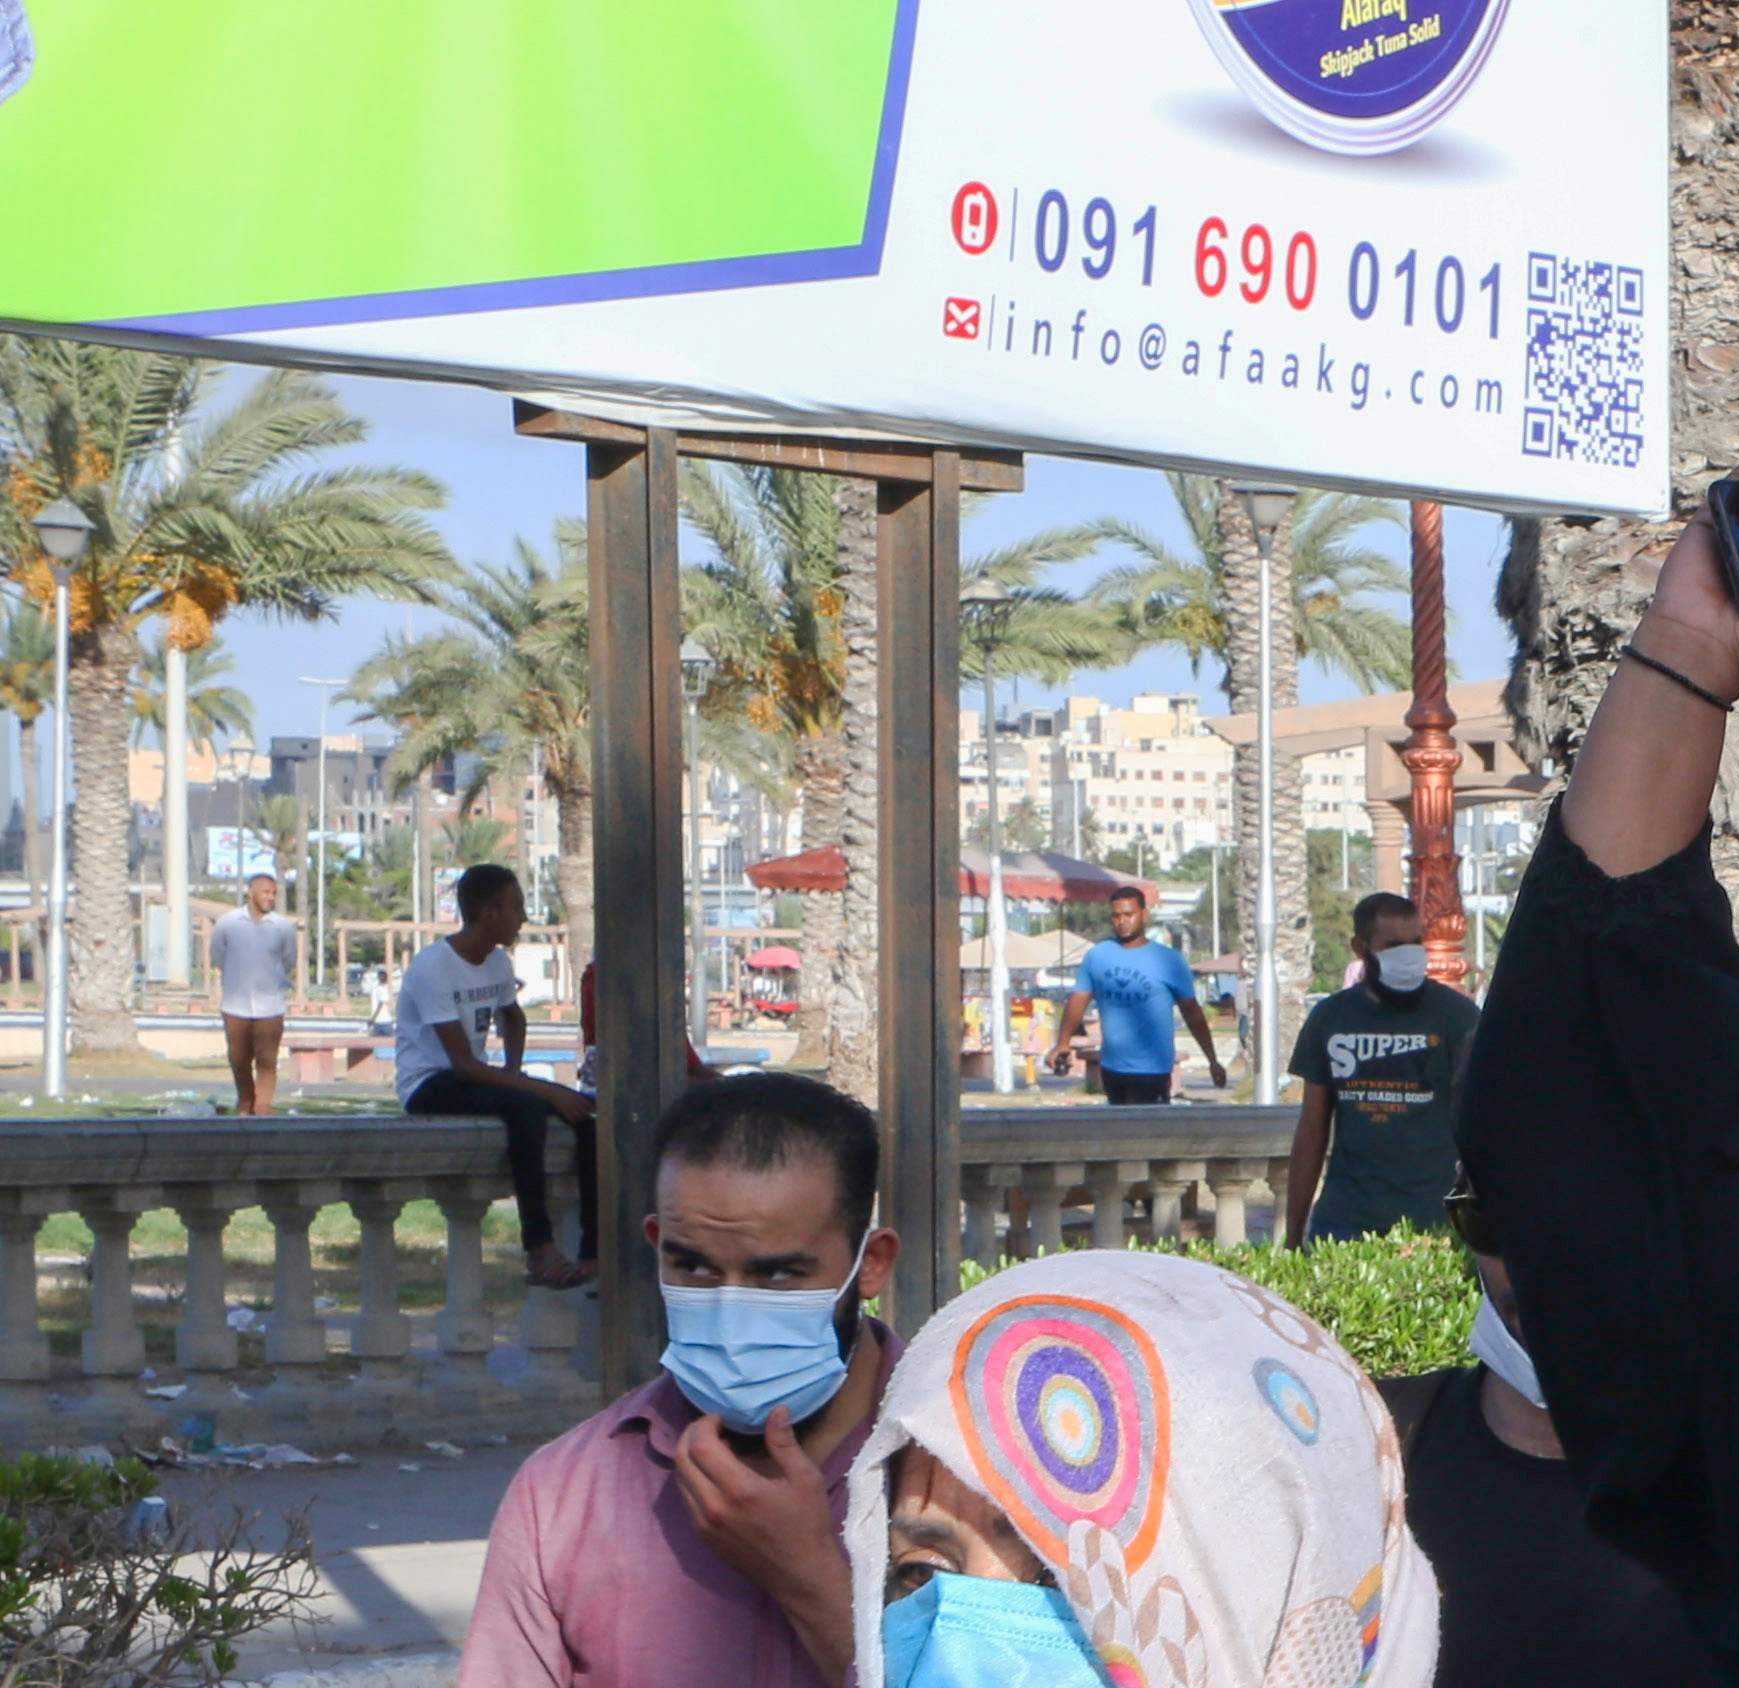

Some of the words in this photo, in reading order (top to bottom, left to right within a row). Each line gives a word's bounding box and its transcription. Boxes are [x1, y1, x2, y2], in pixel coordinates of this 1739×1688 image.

[1320, 39, 1375, 78] Skipjack
[1376, 30, 1407, 57] Tuna
[1408, 14, 1441, 47] Solid
[1034, 188, 1158, 287] 091
[1195, 216, 1318, 311] 690
[1348, 240, 1502, 339] 0101
[1004, 301, 1504, 415] info@afaakg.com
[1327, 1033, 1427, 1079] SUPER
